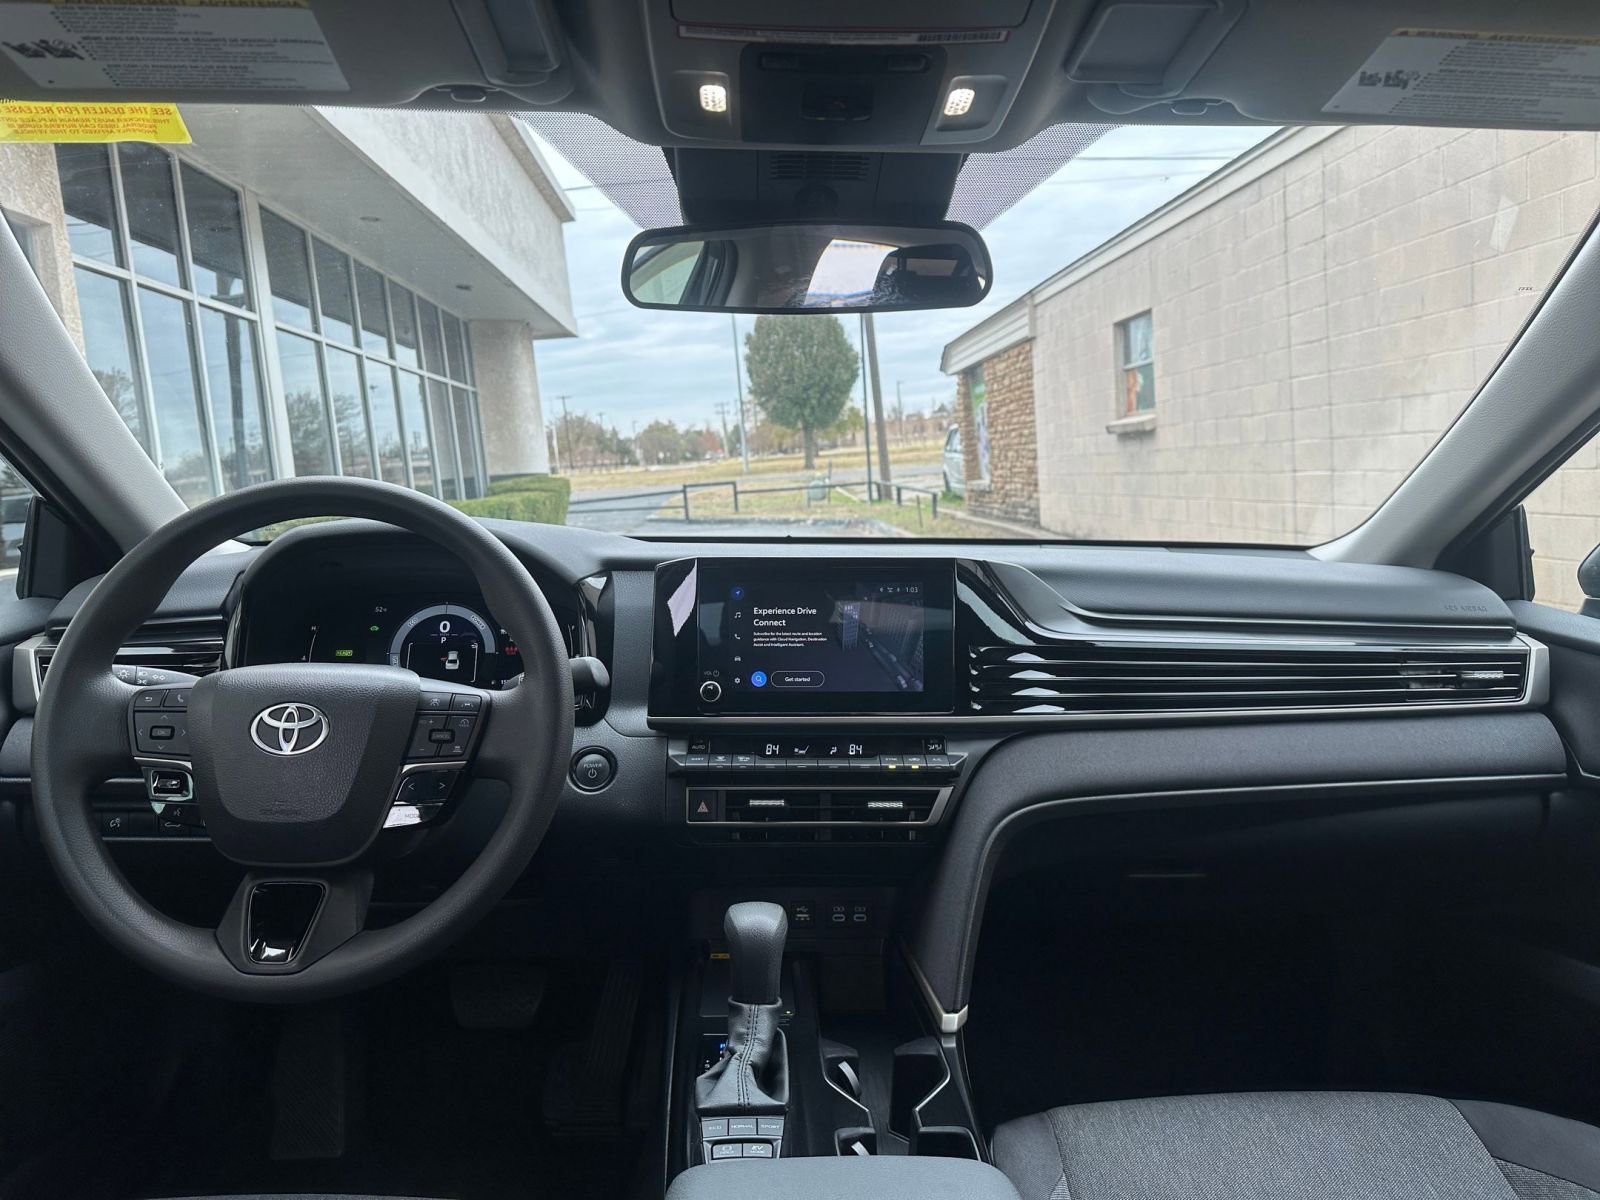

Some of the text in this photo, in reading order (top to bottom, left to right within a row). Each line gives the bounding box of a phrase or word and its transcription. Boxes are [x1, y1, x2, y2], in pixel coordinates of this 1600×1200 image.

[753, 606, 817, 616] Experience Drive
[753, 618, 787, 627] Connect
[765, 743, 780, 755] 84
[848, 743, 863, 755] 84
